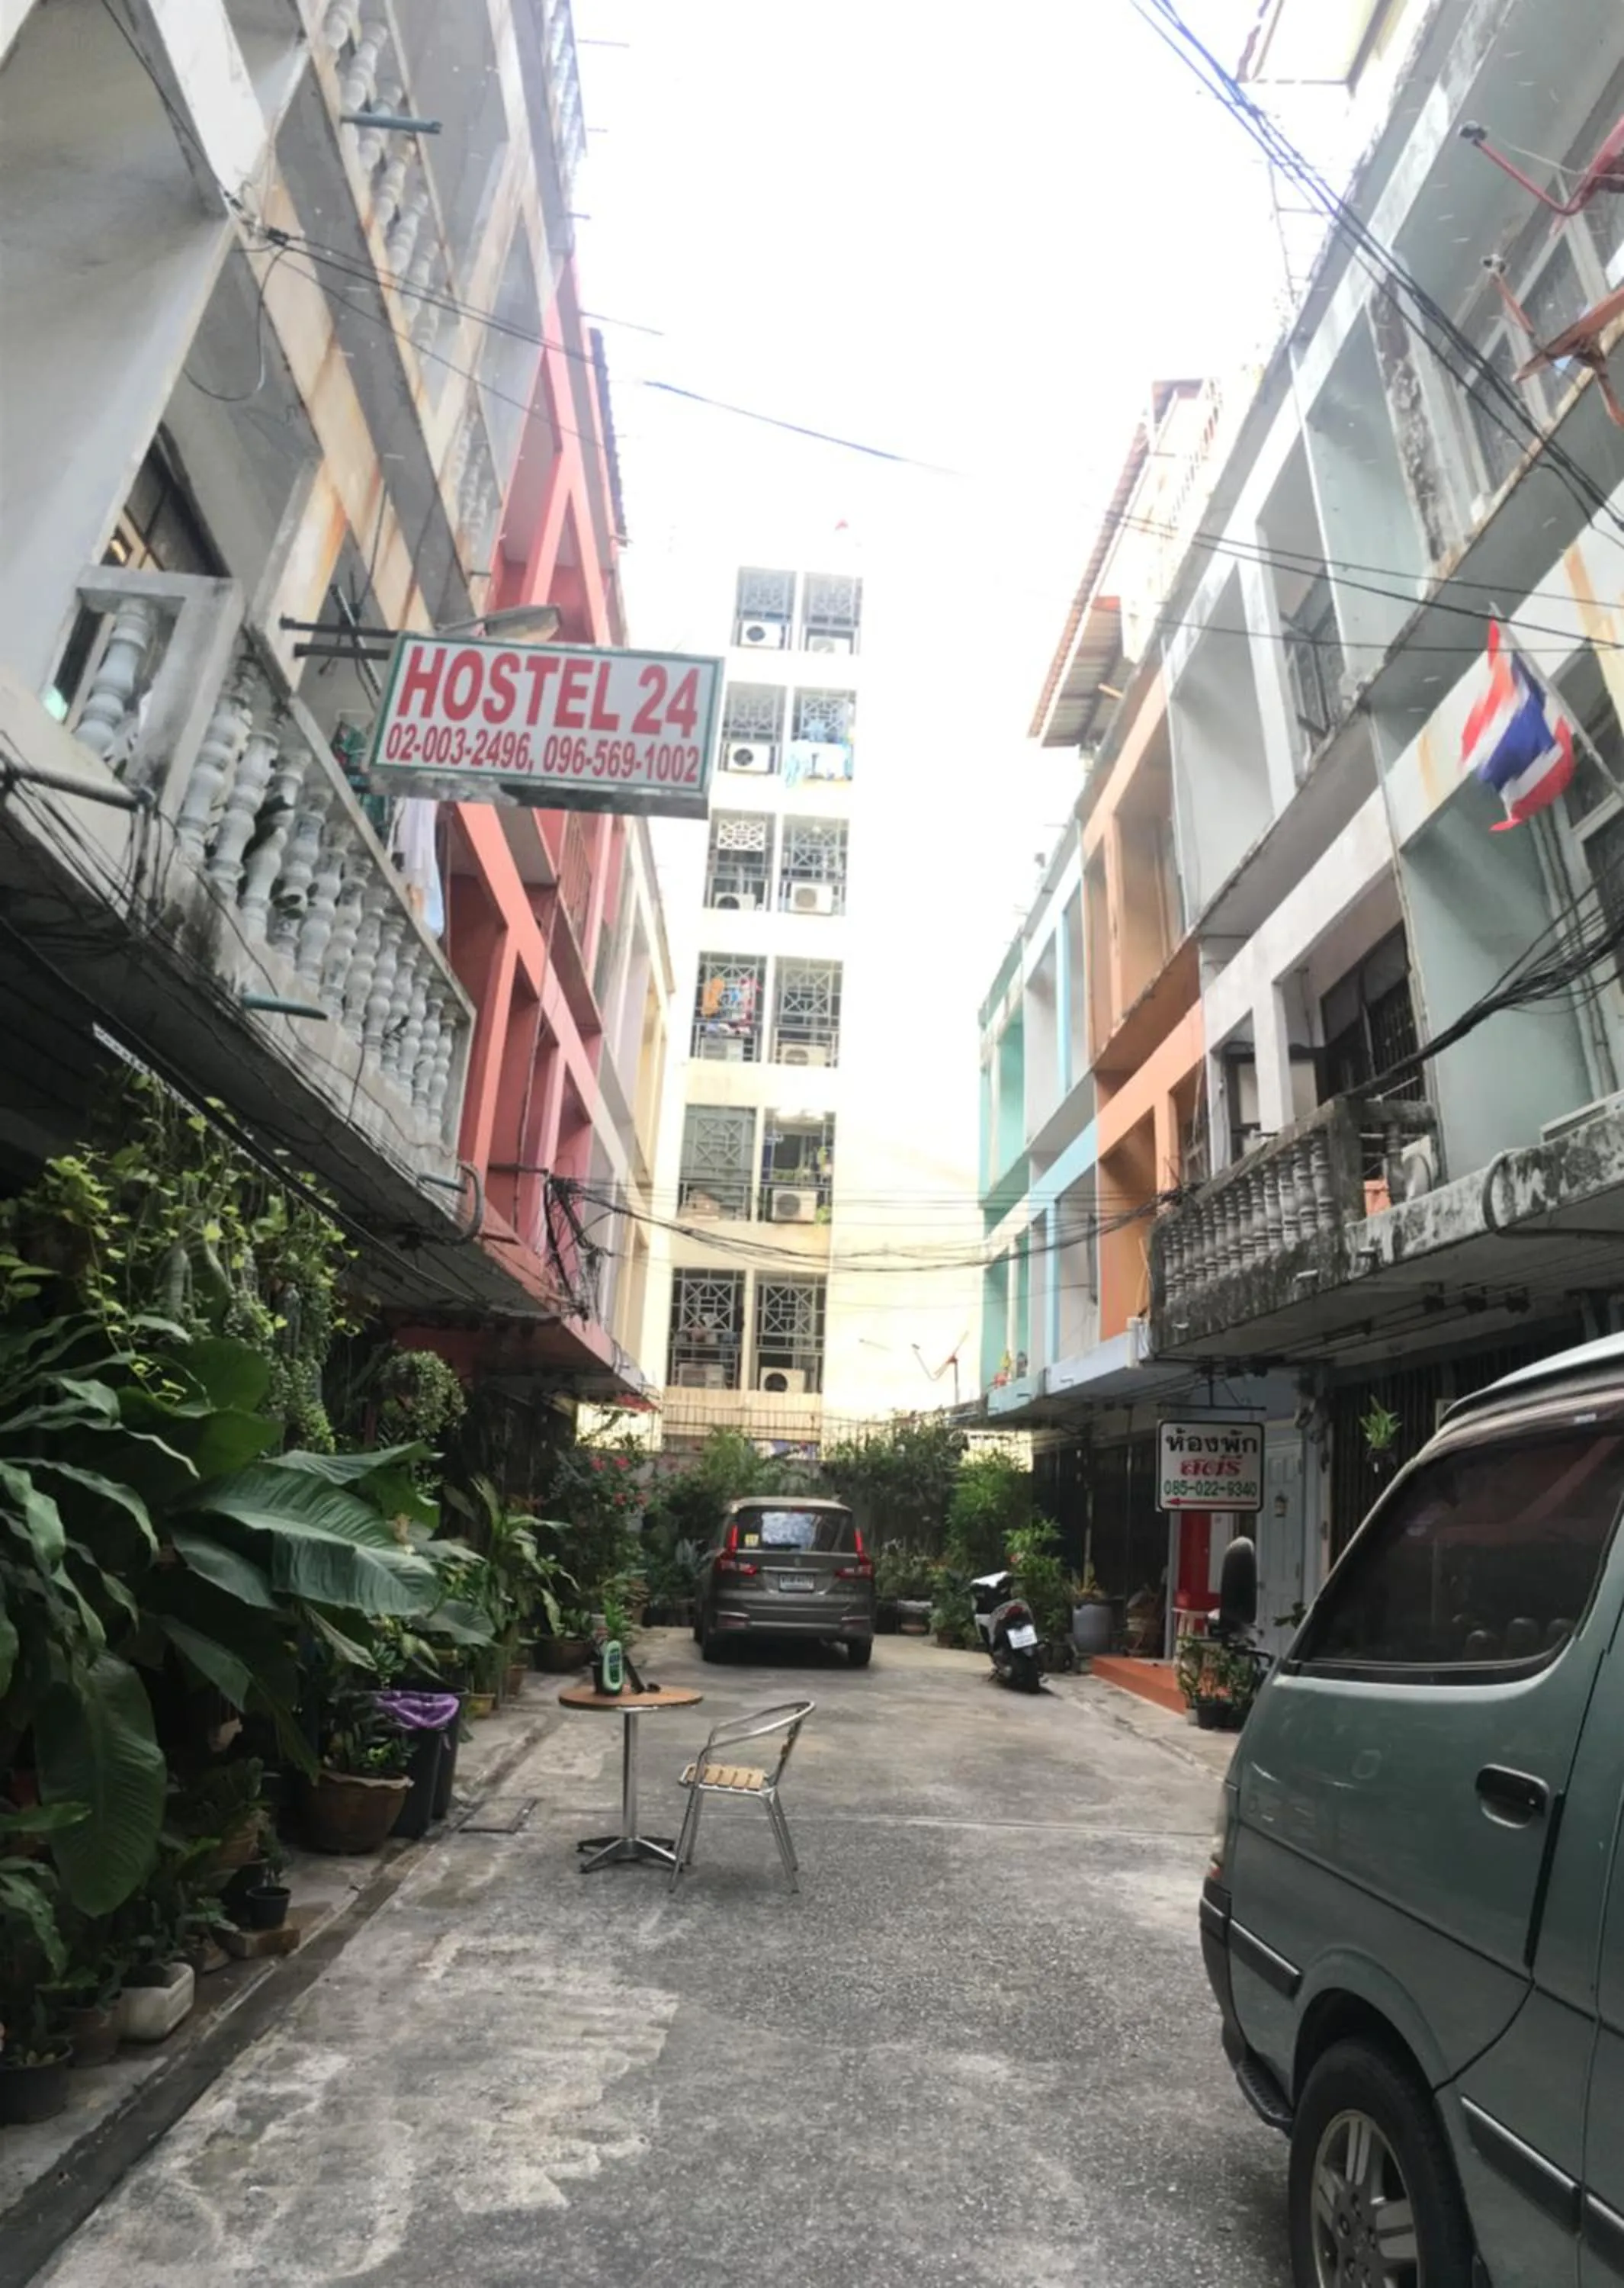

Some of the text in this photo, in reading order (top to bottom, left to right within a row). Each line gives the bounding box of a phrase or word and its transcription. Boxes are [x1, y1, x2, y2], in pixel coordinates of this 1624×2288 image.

[396, 645, 701, 738] HOSTEL 24
[387, 722, 699, 783] 02-003-2496, 096-569-1002
[1165, 1427, 1257, 1453] ห้องพัก
